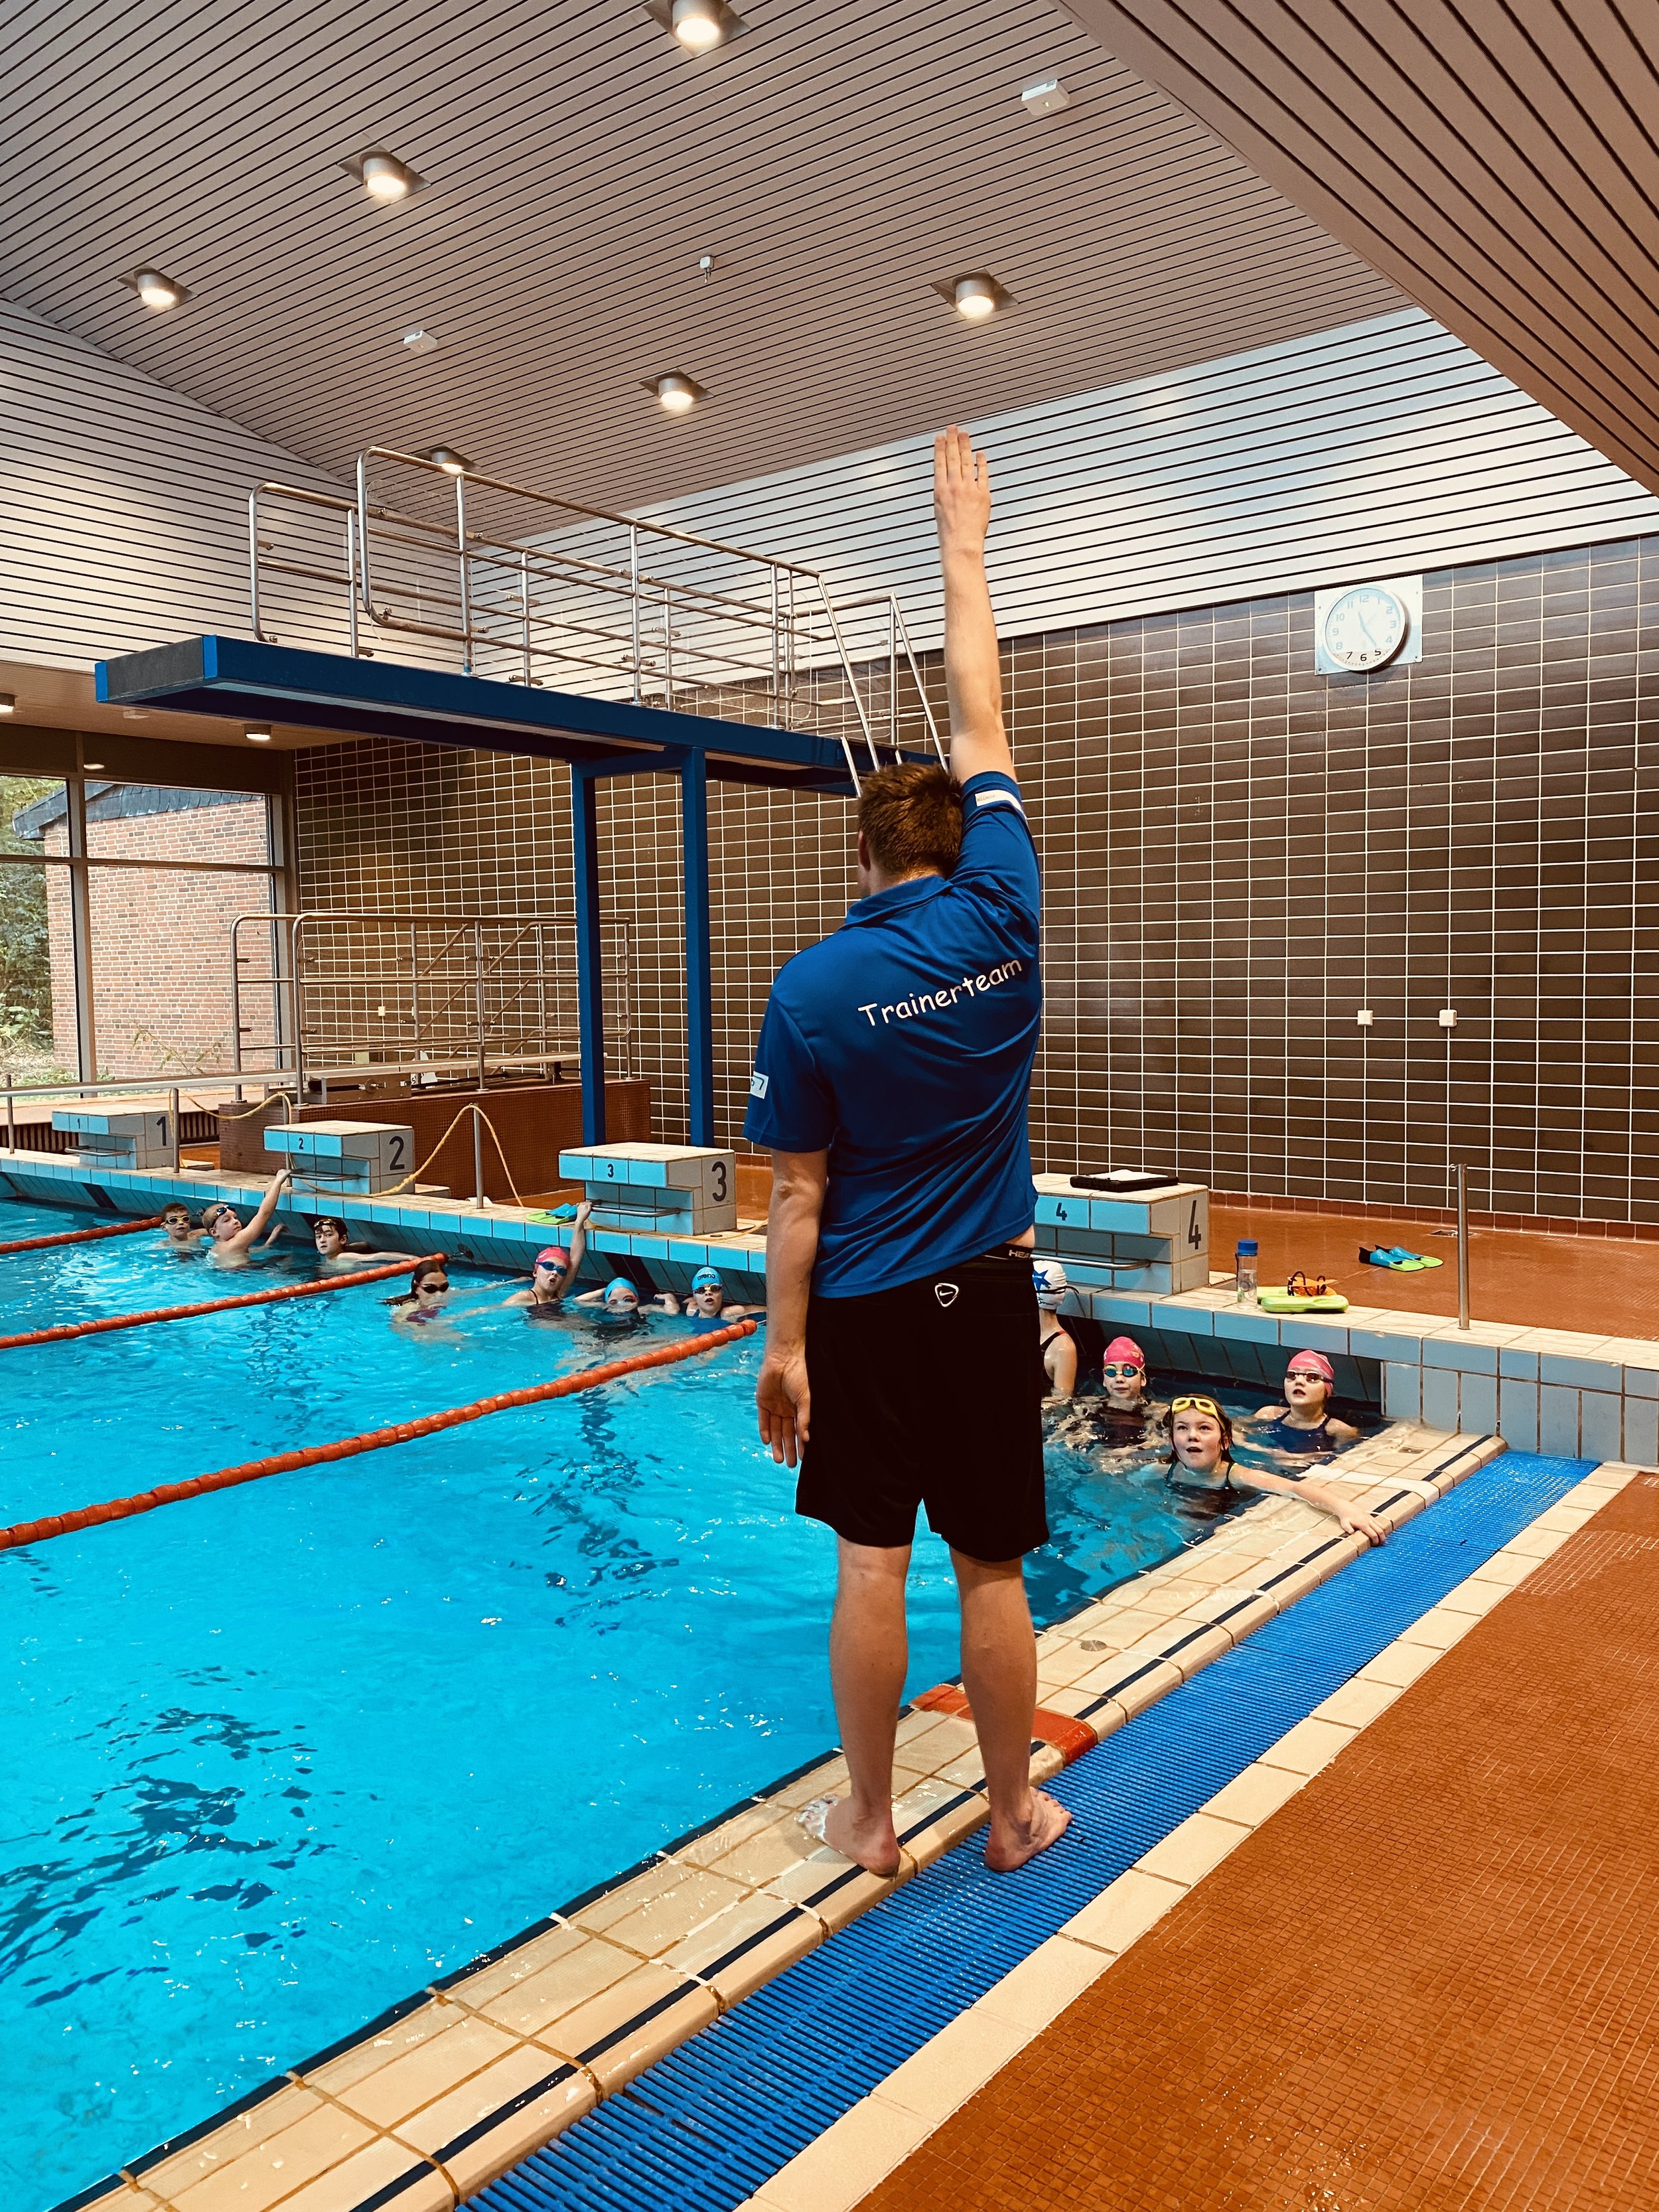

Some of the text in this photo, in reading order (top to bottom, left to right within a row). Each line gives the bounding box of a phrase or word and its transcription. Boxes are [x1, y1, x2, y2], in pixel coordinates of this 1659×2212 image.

[1347, 601, 1354, 609] 11
[1359, 595, 1369, 603] 12
[1346, 651, 1353, 660] 7
[857, 959, 1022, 1026] Trainerteam
[77, 1118, 80, 1129] 1
[156, 1116, 167, 1146] 1
[299, 1138, 304, 1149] 2
[389, 1136, 405, 1171] 2
[607, 1163, 614, 1178] 3
[711, 1161, 727, 1202] 3
[1056, 1202, 1068, 1221] 4
[1188, 1200, 1202, 1250] 4
